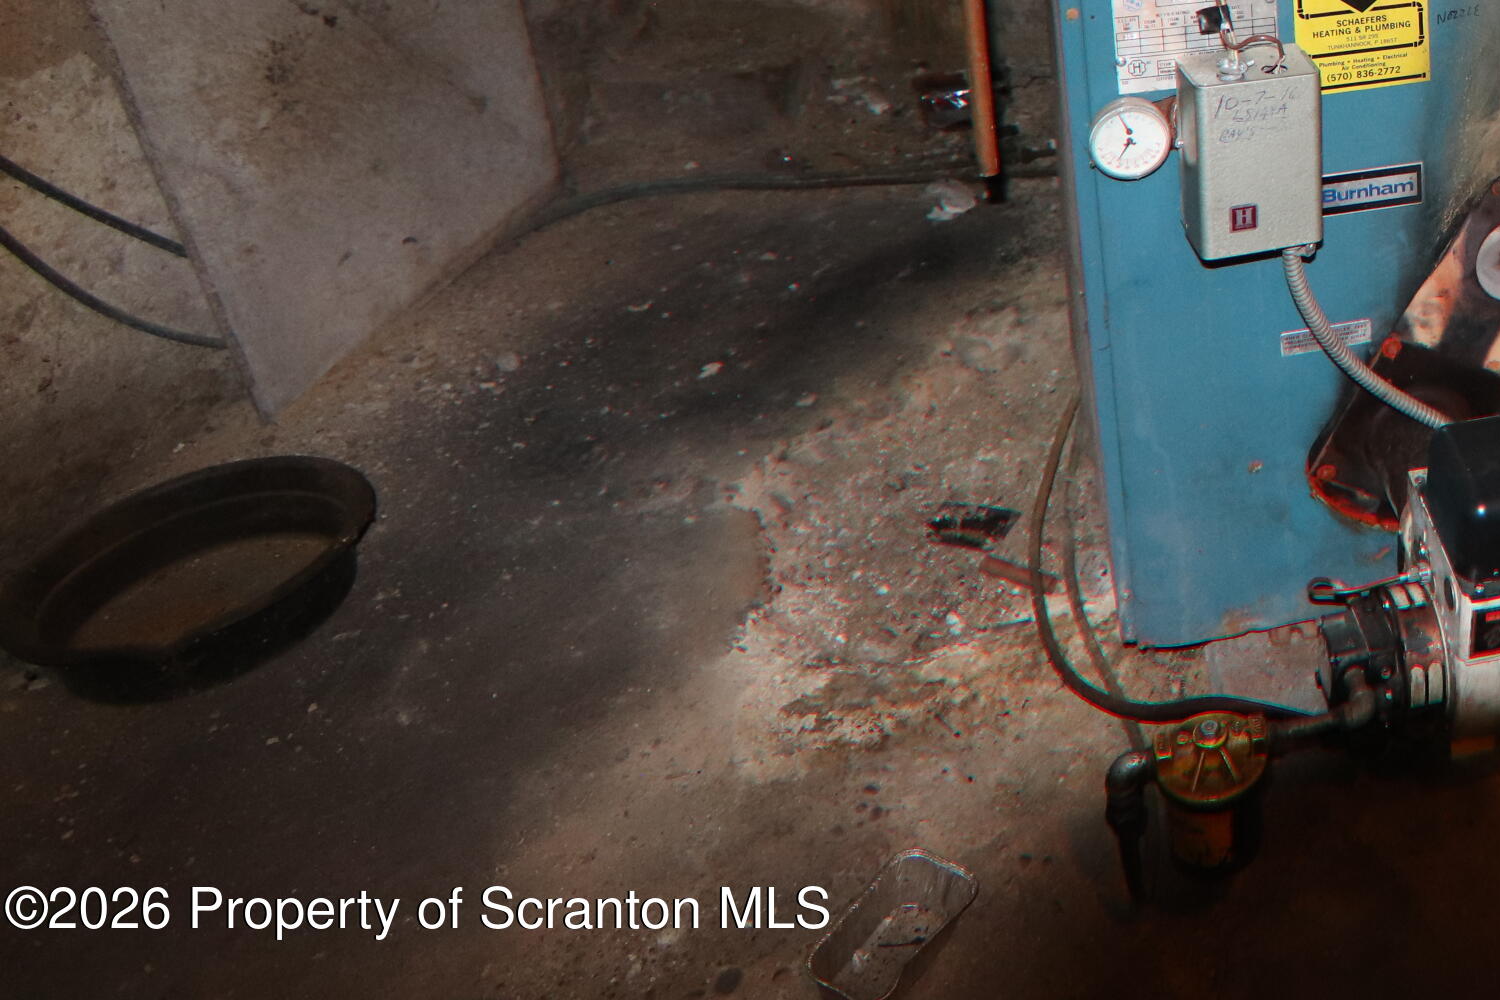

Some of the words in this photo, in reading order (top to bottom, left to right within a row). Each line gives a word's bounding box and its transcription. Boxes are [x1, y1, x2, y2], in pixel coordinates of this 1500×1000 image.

[1312, 27, 1352, 39] HEATING
[1354, 26, 1361, 34] &
[1364, 20, 1411, 33] PLUMBING
[1336, 15, 1387, 27] SCHAEFERS
[1319, 60, 1345, 69] Plumbing
[1383, 52, 1408, 60] Electrical
[1352, 61, 1386, 70] Conditioning
[1326, 72, 1353, 83] (570)
[1356, 66, 1401, 79] 836-2772
[1321, 180, 1414, 203] Burnham
